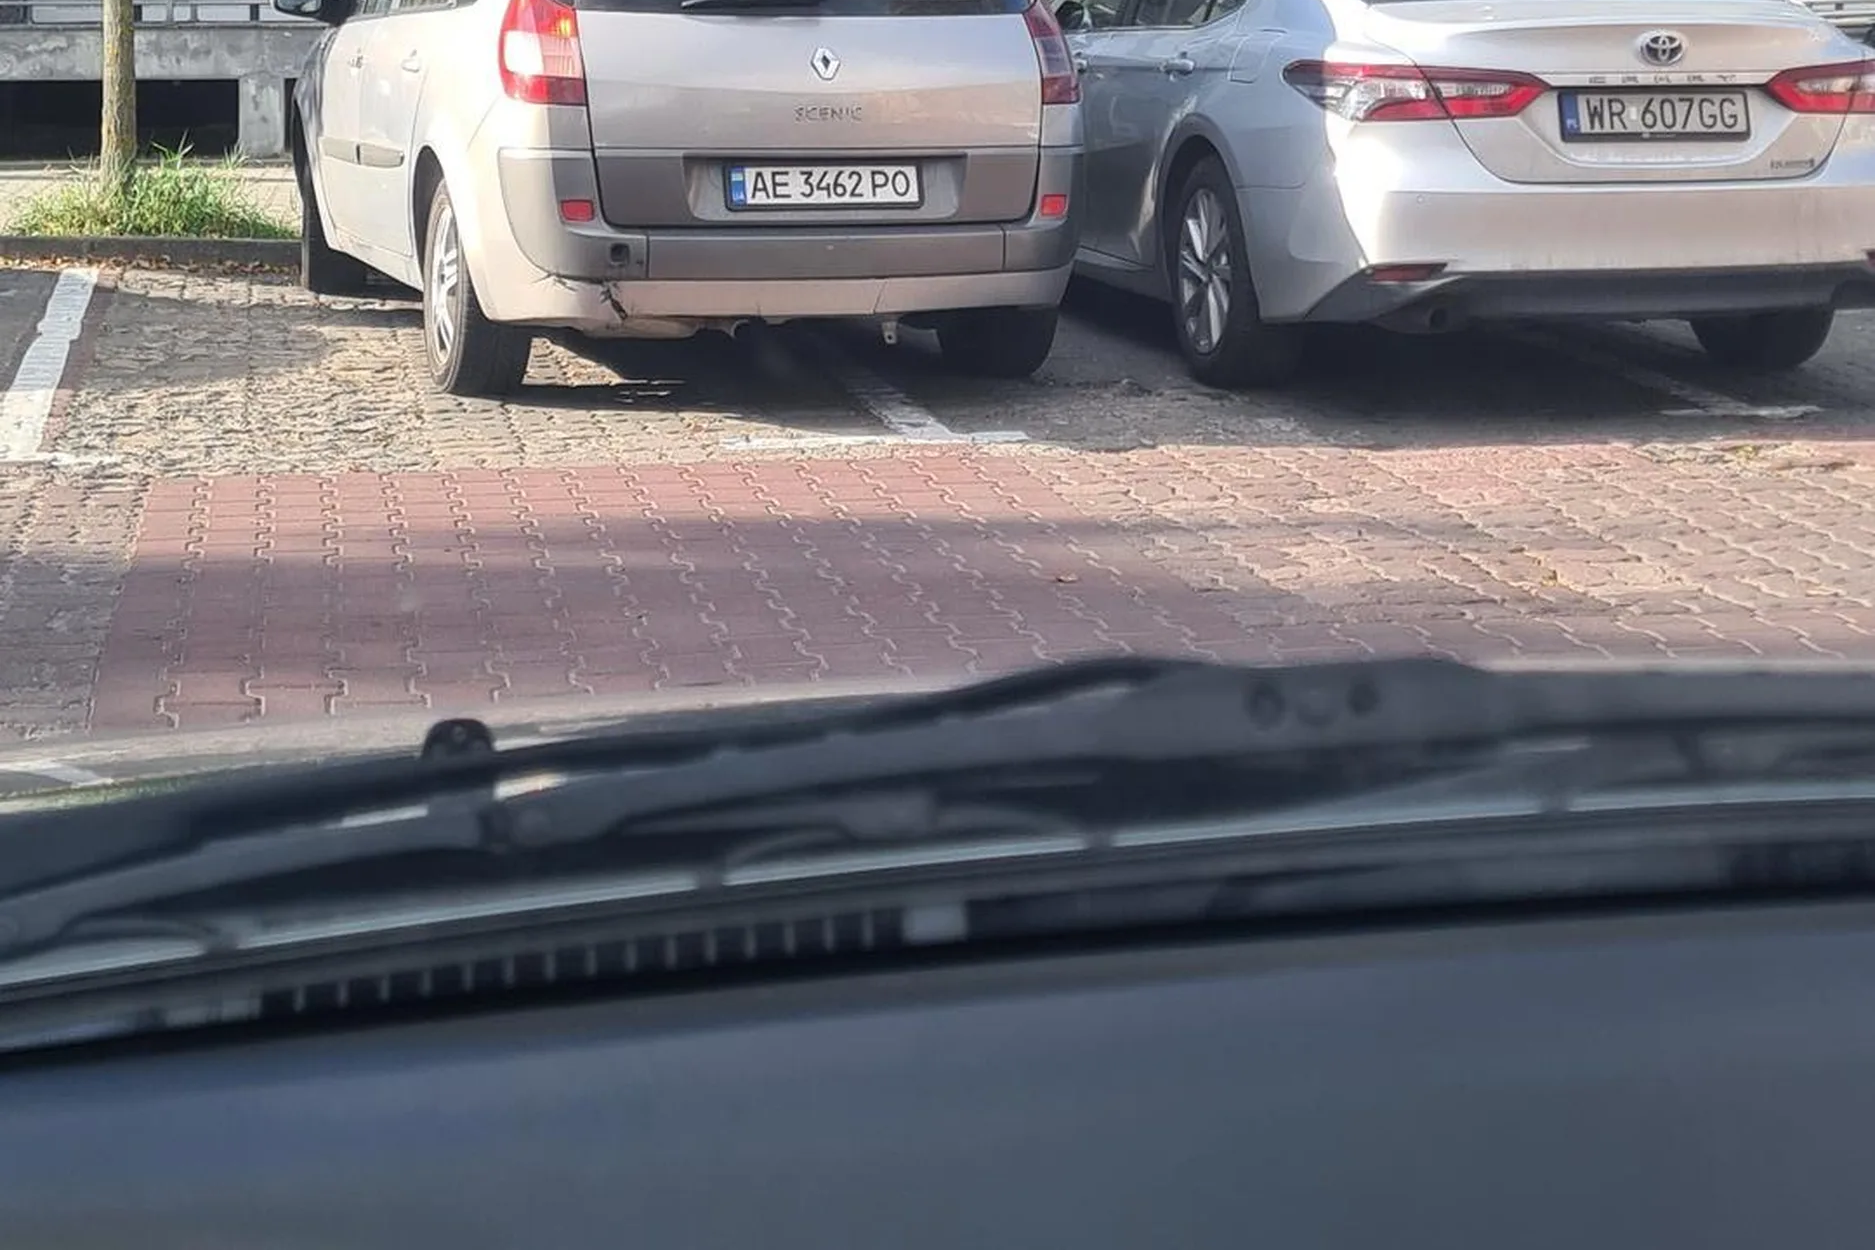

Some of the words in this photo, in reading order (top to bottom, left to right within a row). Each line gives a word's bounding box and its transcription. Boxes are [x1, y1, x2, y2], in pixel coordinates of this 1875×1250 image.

[794, 106, 863, 122] SCENIC
[1586, 97, 1628, 130] WR
[1640, 97, 1739, 130] 607GG
[751, 170, 792, 198] AE
[800, 170, 864, 198] 3462
[871, 170, 911, 197] PO
